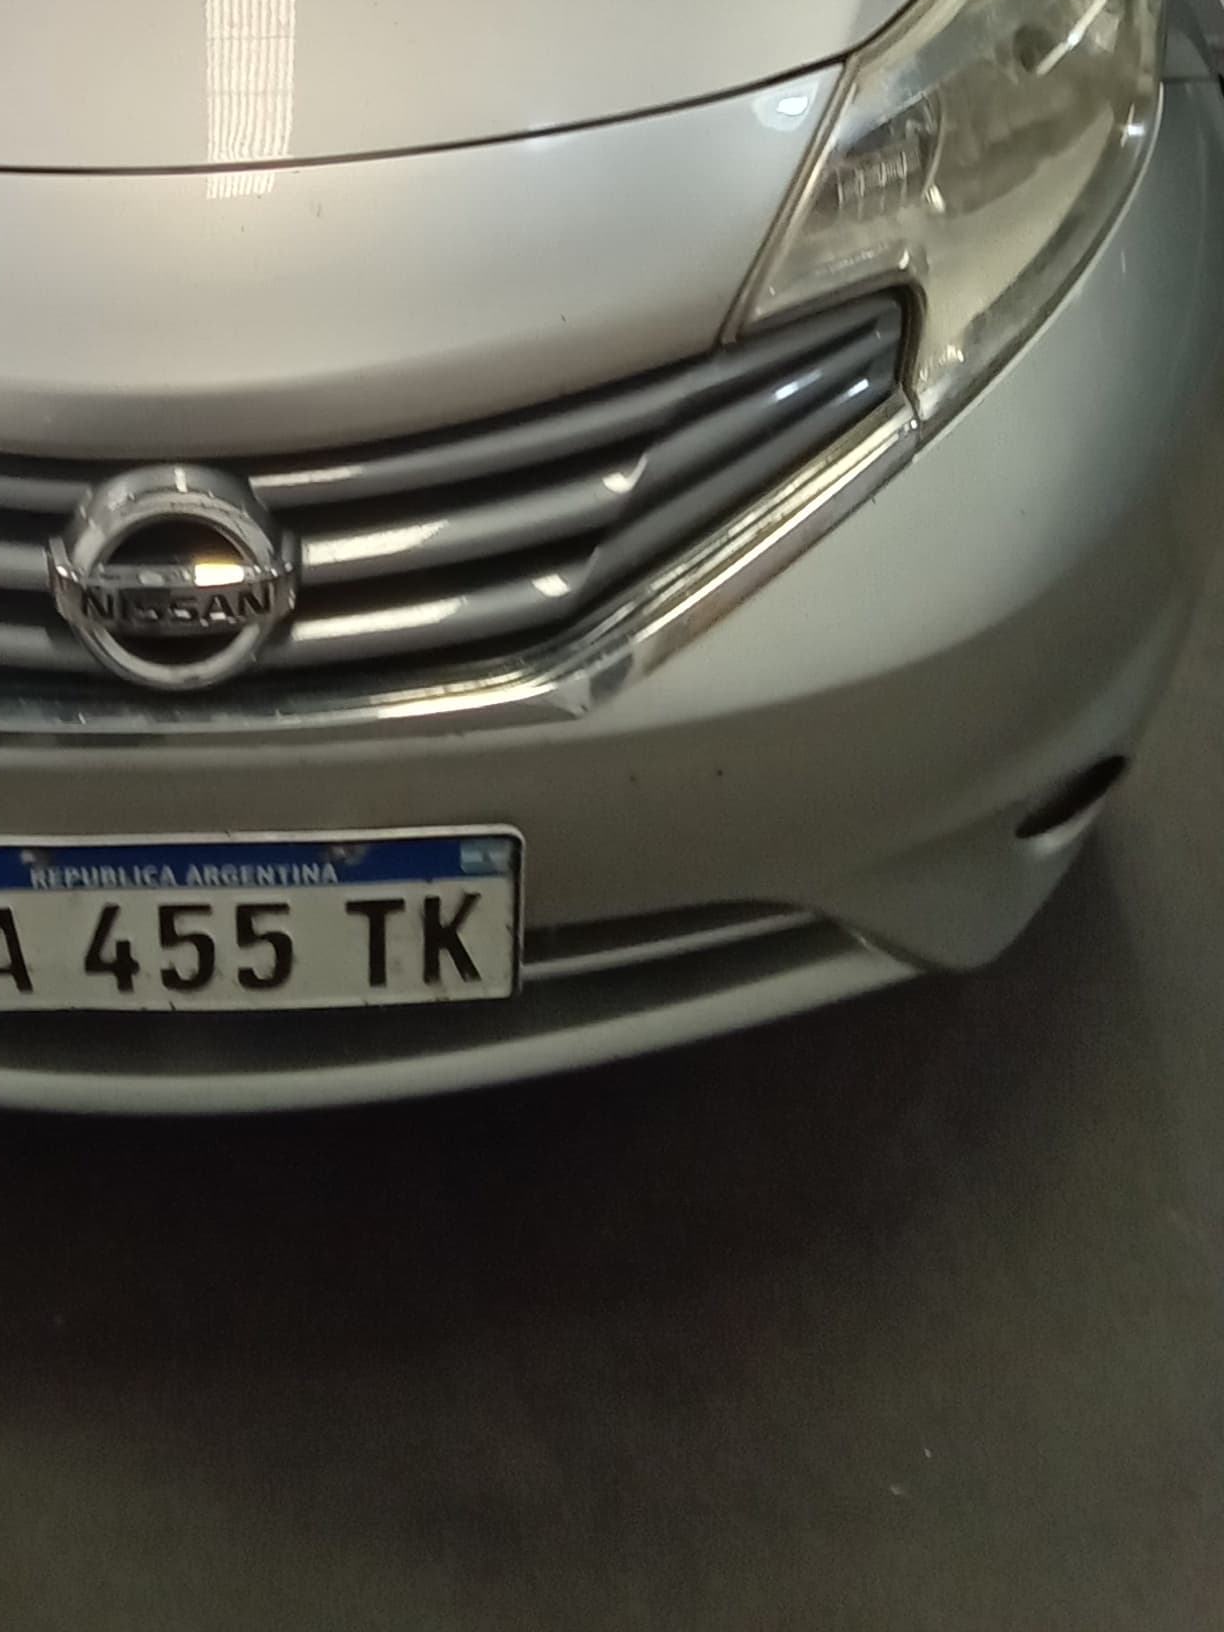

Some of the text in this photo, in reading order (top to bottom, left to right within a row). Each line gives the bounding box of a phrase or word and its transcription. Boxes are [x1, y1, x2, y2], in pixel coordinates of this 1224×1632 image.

[81, 582, 275, 621] NISSAN
[30, 861, 339, 889] REPUBLICA ARGENTINA
[84, 904, 295, 995] 455
[345, 892, 483, 988] TK
